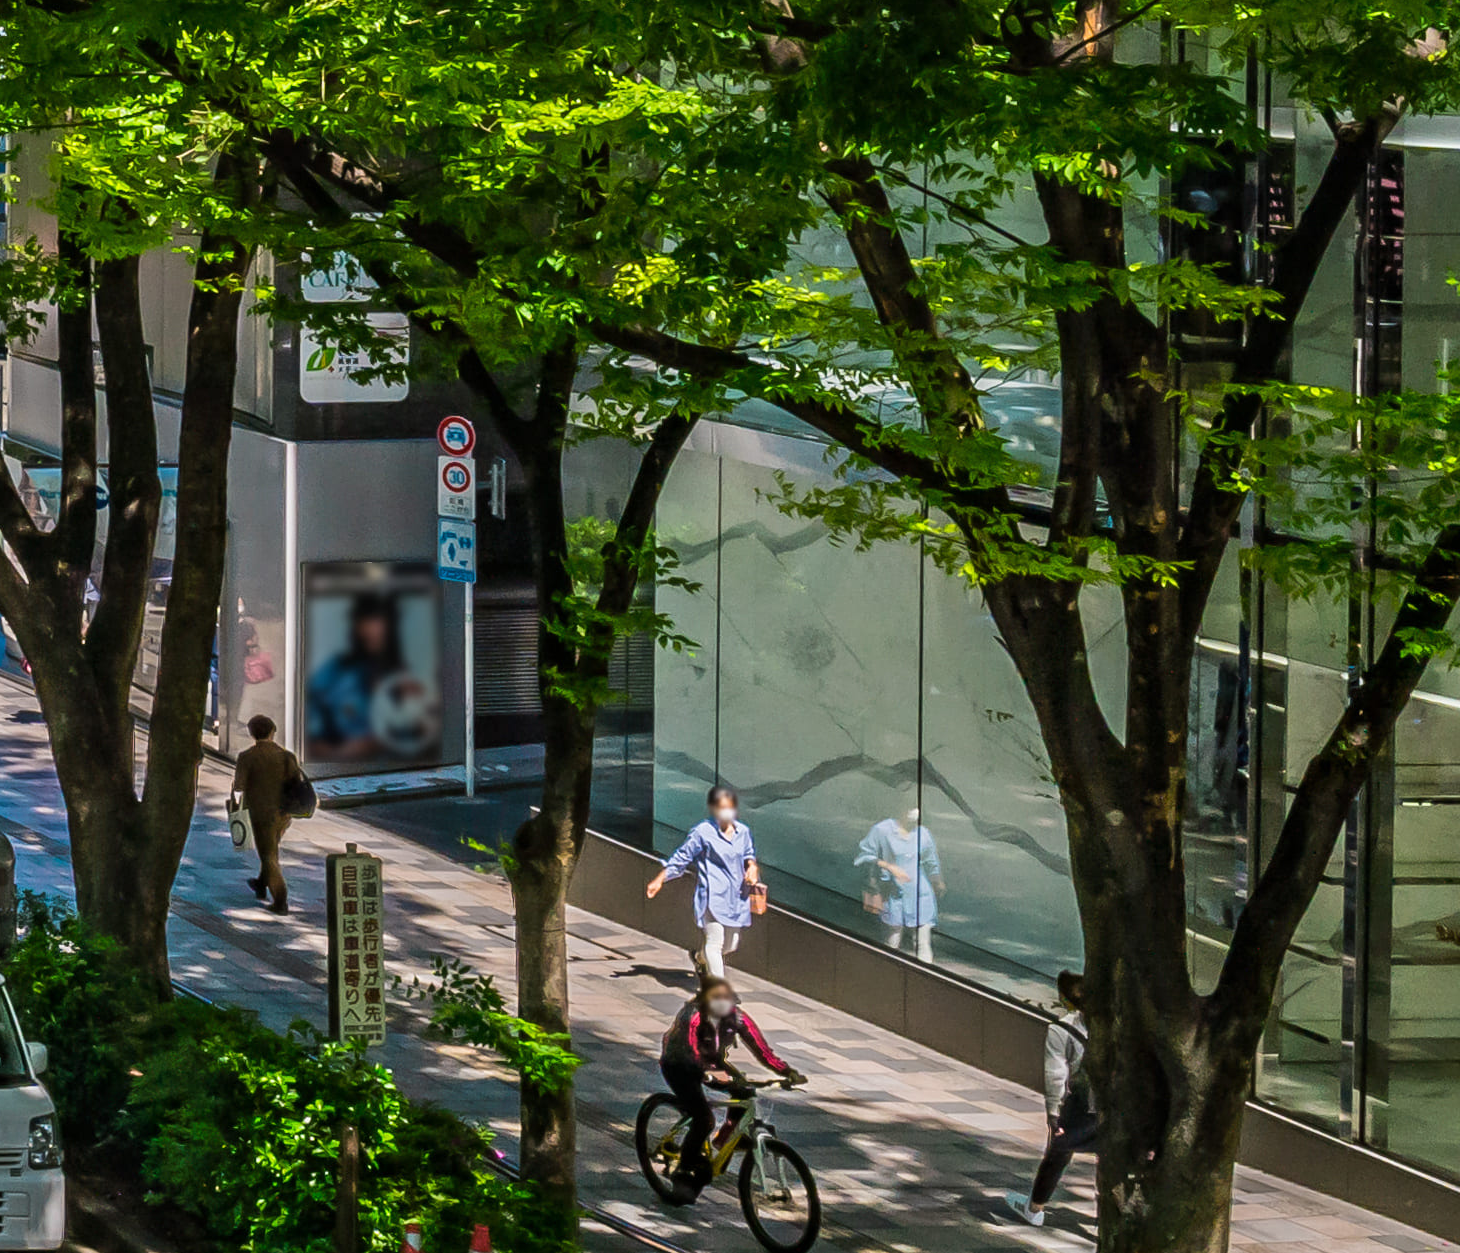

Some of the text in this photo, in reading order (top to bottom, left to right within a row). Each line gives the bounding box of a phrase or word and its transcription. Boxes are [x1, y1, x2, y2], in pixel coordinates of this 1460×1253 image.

[448, 469, 465, 485] 30
[341, 864, 362, 1023] 自転車は車道寄りへ
[362, 864, 383, 1023] 歩道は歩行者が優先
